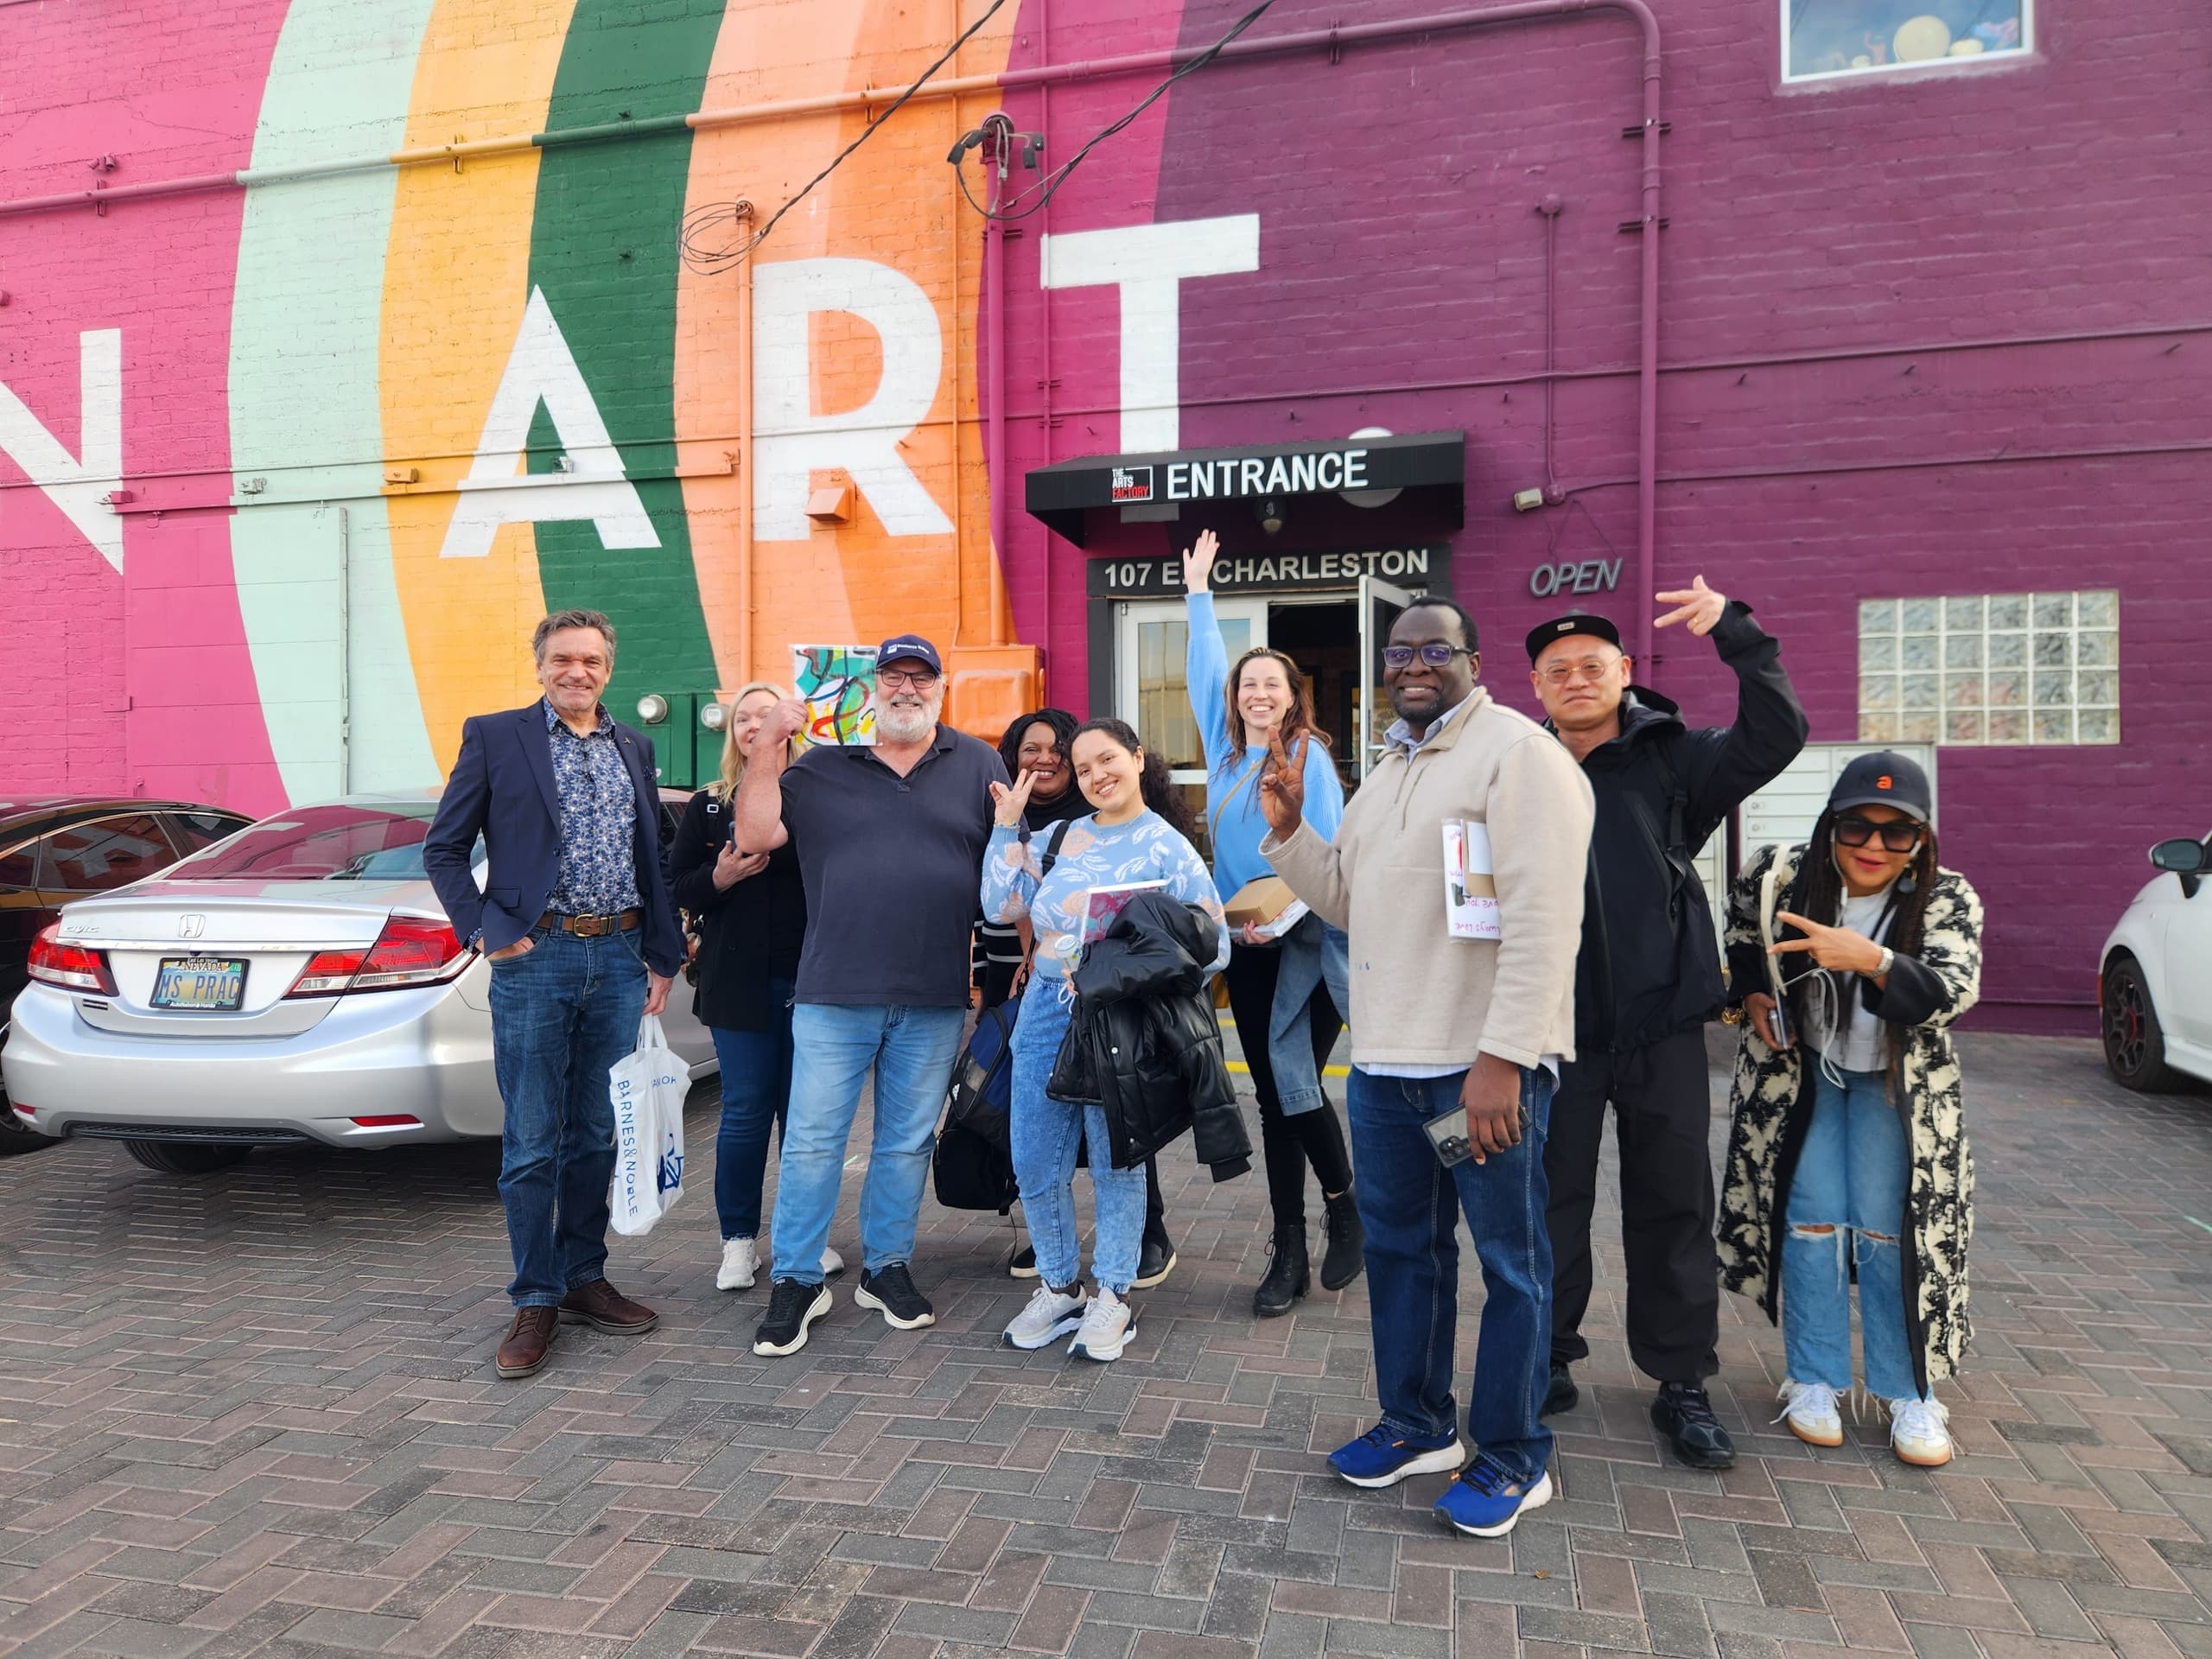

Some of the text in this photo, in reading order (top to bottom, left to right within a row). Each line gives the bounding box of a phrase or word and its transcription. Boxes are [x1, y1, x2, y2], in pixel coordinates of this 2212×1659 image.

[1112, 467, 1125, 478] THE
[1112, 475, 1134, 489] ARTS
[1167, 449, 1369, 499] ENTRANCE
[1112, 485, 1149, 499] FACTORY
[1104, 563, 1153, 588] 107
[1212, 549, 1428, 584] CHARLESTON
[1529, 557, 1623, 597] OPEN
[184, 963, 222, 971] NEVADA
[159, 974, 240, 1000] MS PRAC
